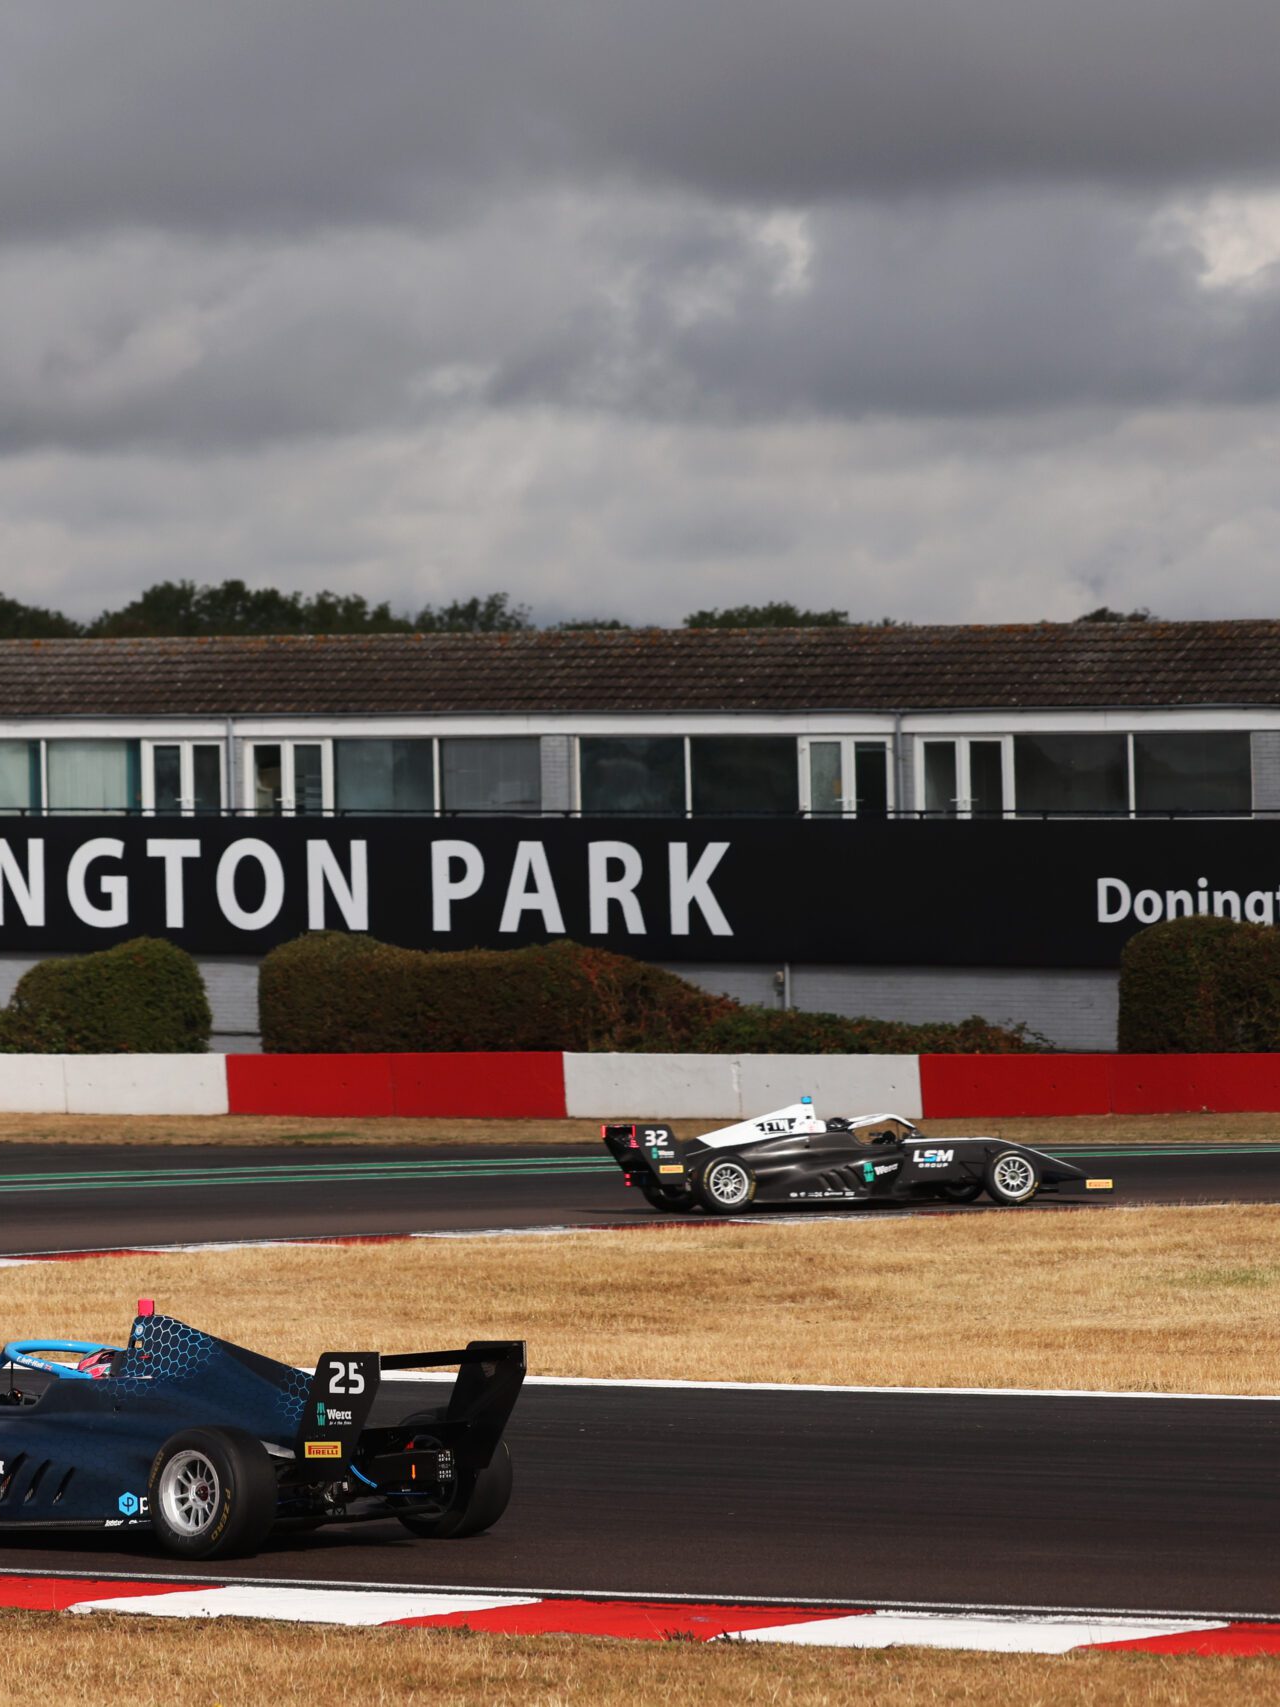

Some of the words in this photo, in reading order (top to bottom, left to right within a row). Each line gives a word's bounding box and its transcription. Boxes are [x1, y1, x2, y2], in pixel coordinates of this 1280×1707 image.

[431, 838, 735, 937] PARK
[1097, 877, 1280, 927] Doning
[644, 1129, 669, 1147] 32
[913, 1149, 954, 1162] LSM
[874, 1163, 899, 1176] Wera
[329, 1361, 365, 1395] 25
[327, 1409, 352, 1420] Wera
[308, 1445, 339, 1456] PIRELLI
[210, 1502, 231, 1542] ZERO
